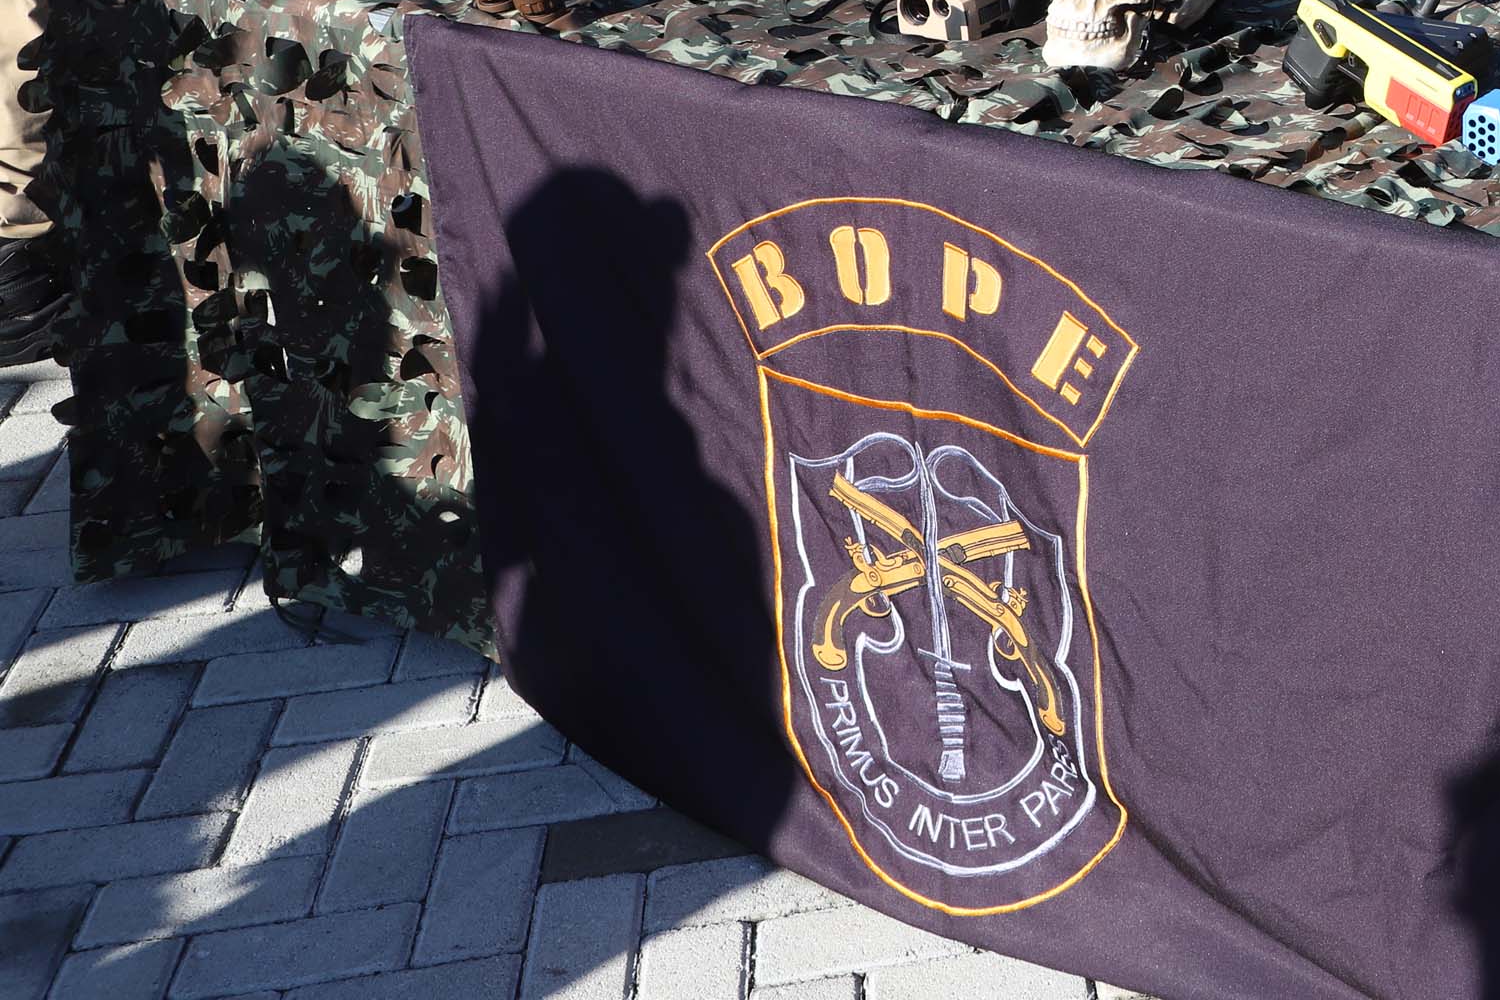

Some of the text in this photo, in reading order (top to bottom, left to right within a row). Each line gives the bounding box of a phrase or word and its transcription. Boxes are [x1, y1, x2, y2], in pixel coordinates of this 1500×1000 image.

[731, 225, 1107, 406] BOPE
[819, 676, 1079, 850] PRIMUS INTER PARES
